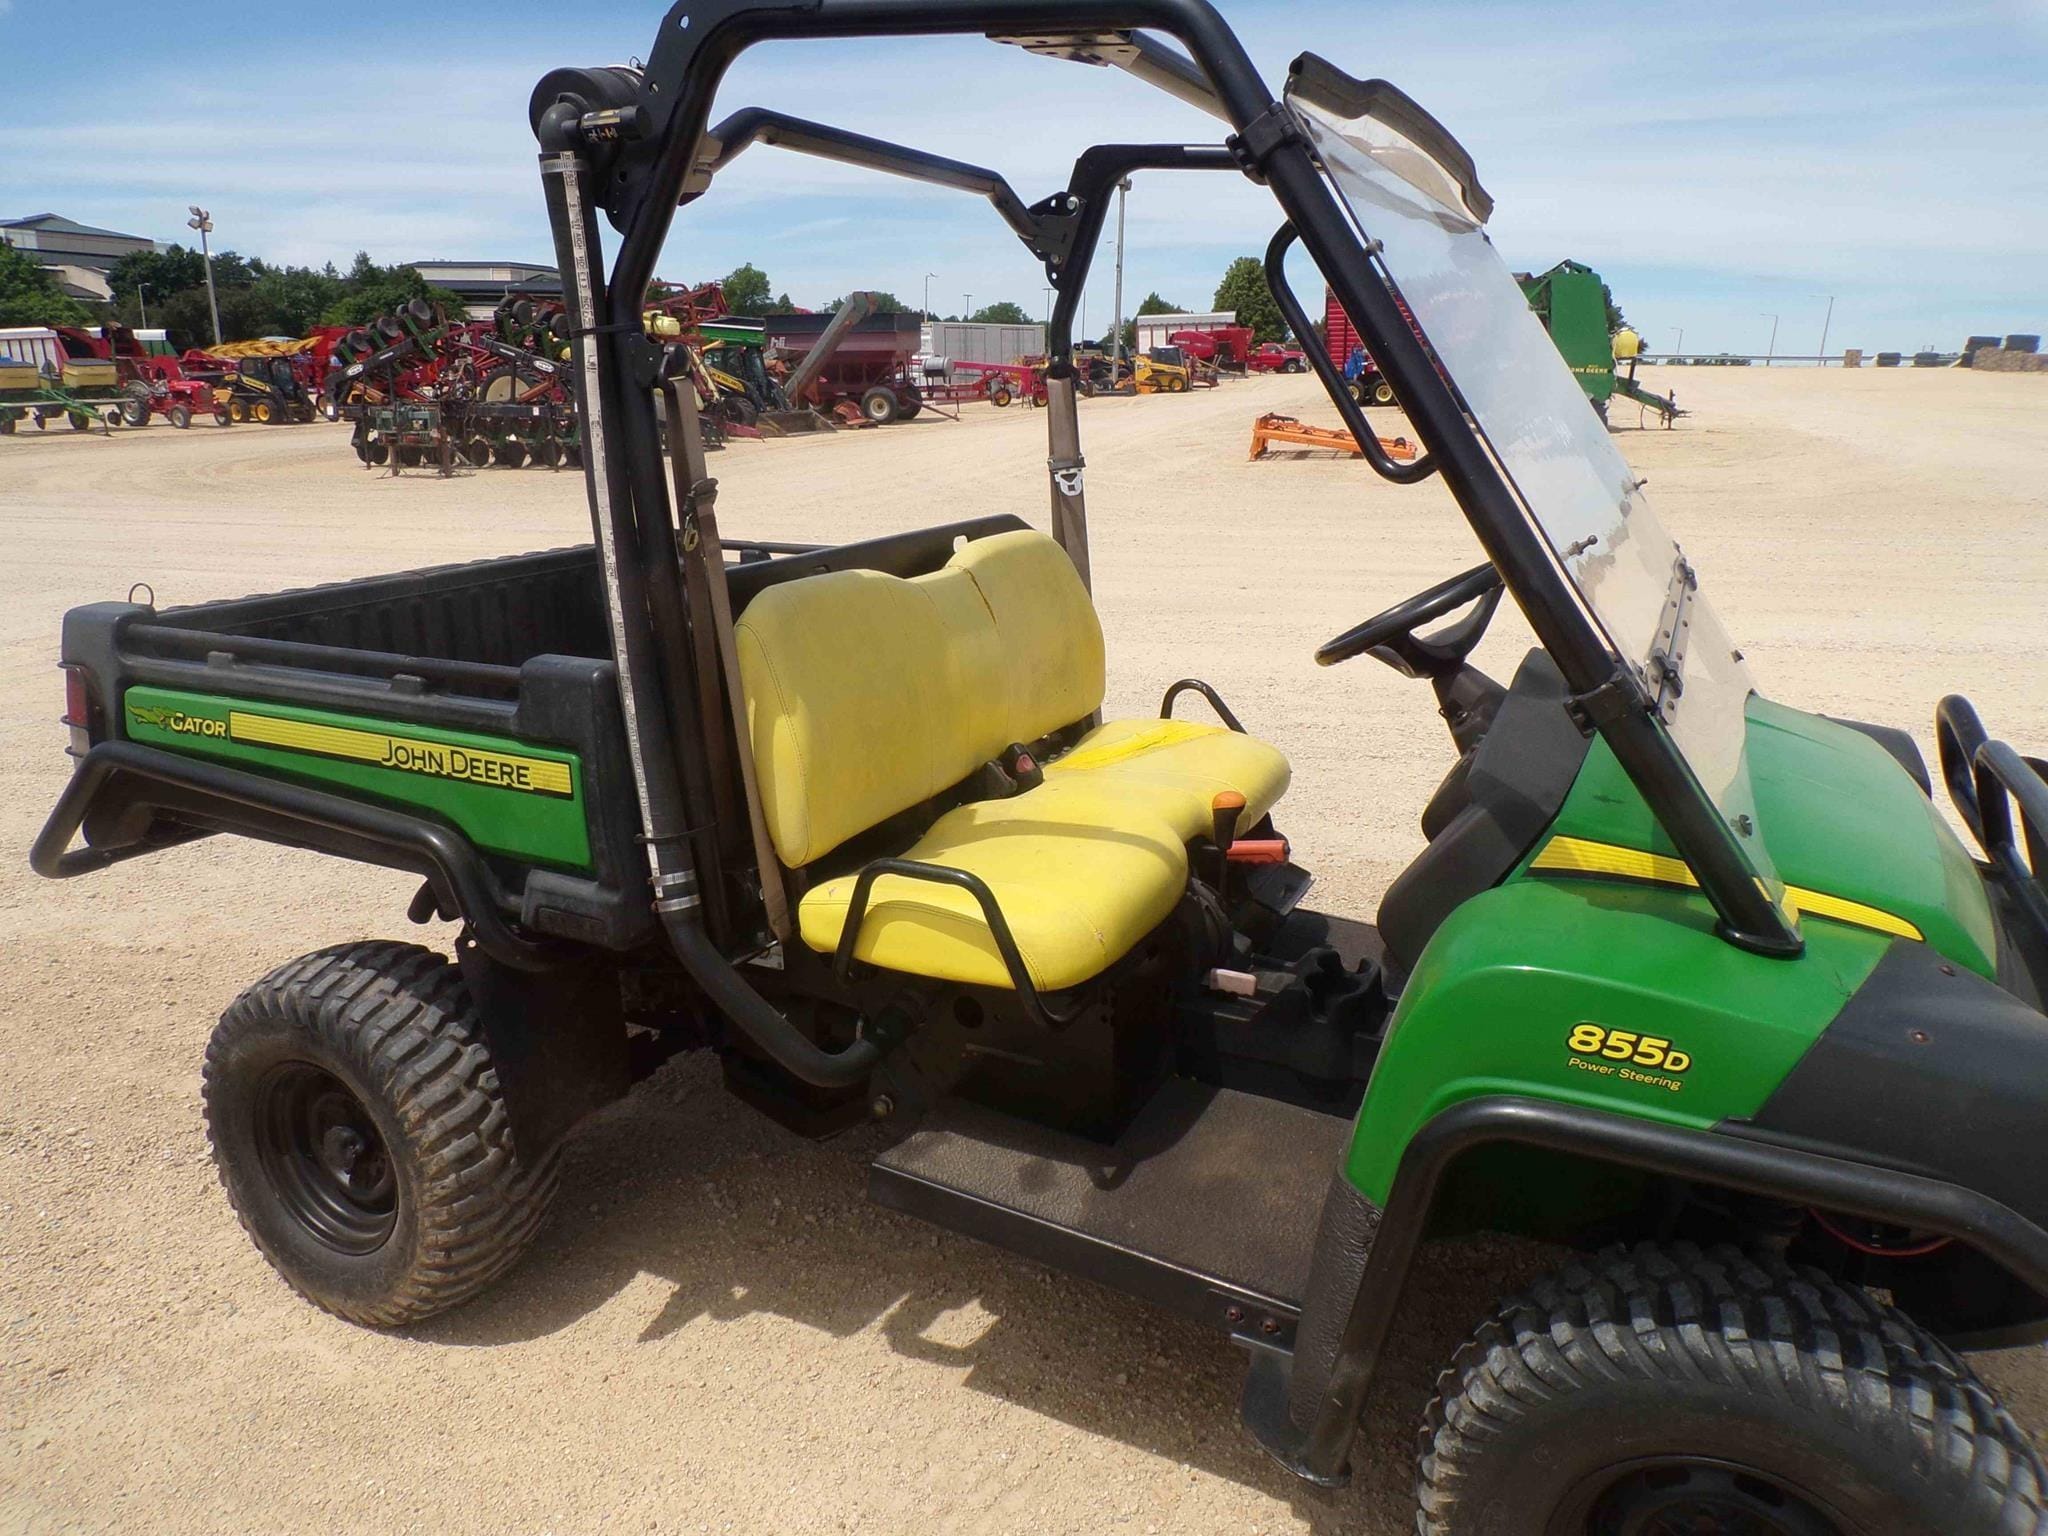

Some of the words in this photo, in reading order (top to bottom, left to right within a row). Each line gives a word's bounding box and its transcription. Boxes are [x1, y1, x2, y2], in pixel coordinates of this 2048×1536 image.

[170, 711, 227, 737] GATOR
[381, 739, 445, 773] JOHN
[450, 749, 532, 787] DEERE
[1567, 1023, 1691, 1073] 855D
[1567, 1057, 1616, 1075] Power
[1618, 1068, 1682, 1091] Steering
